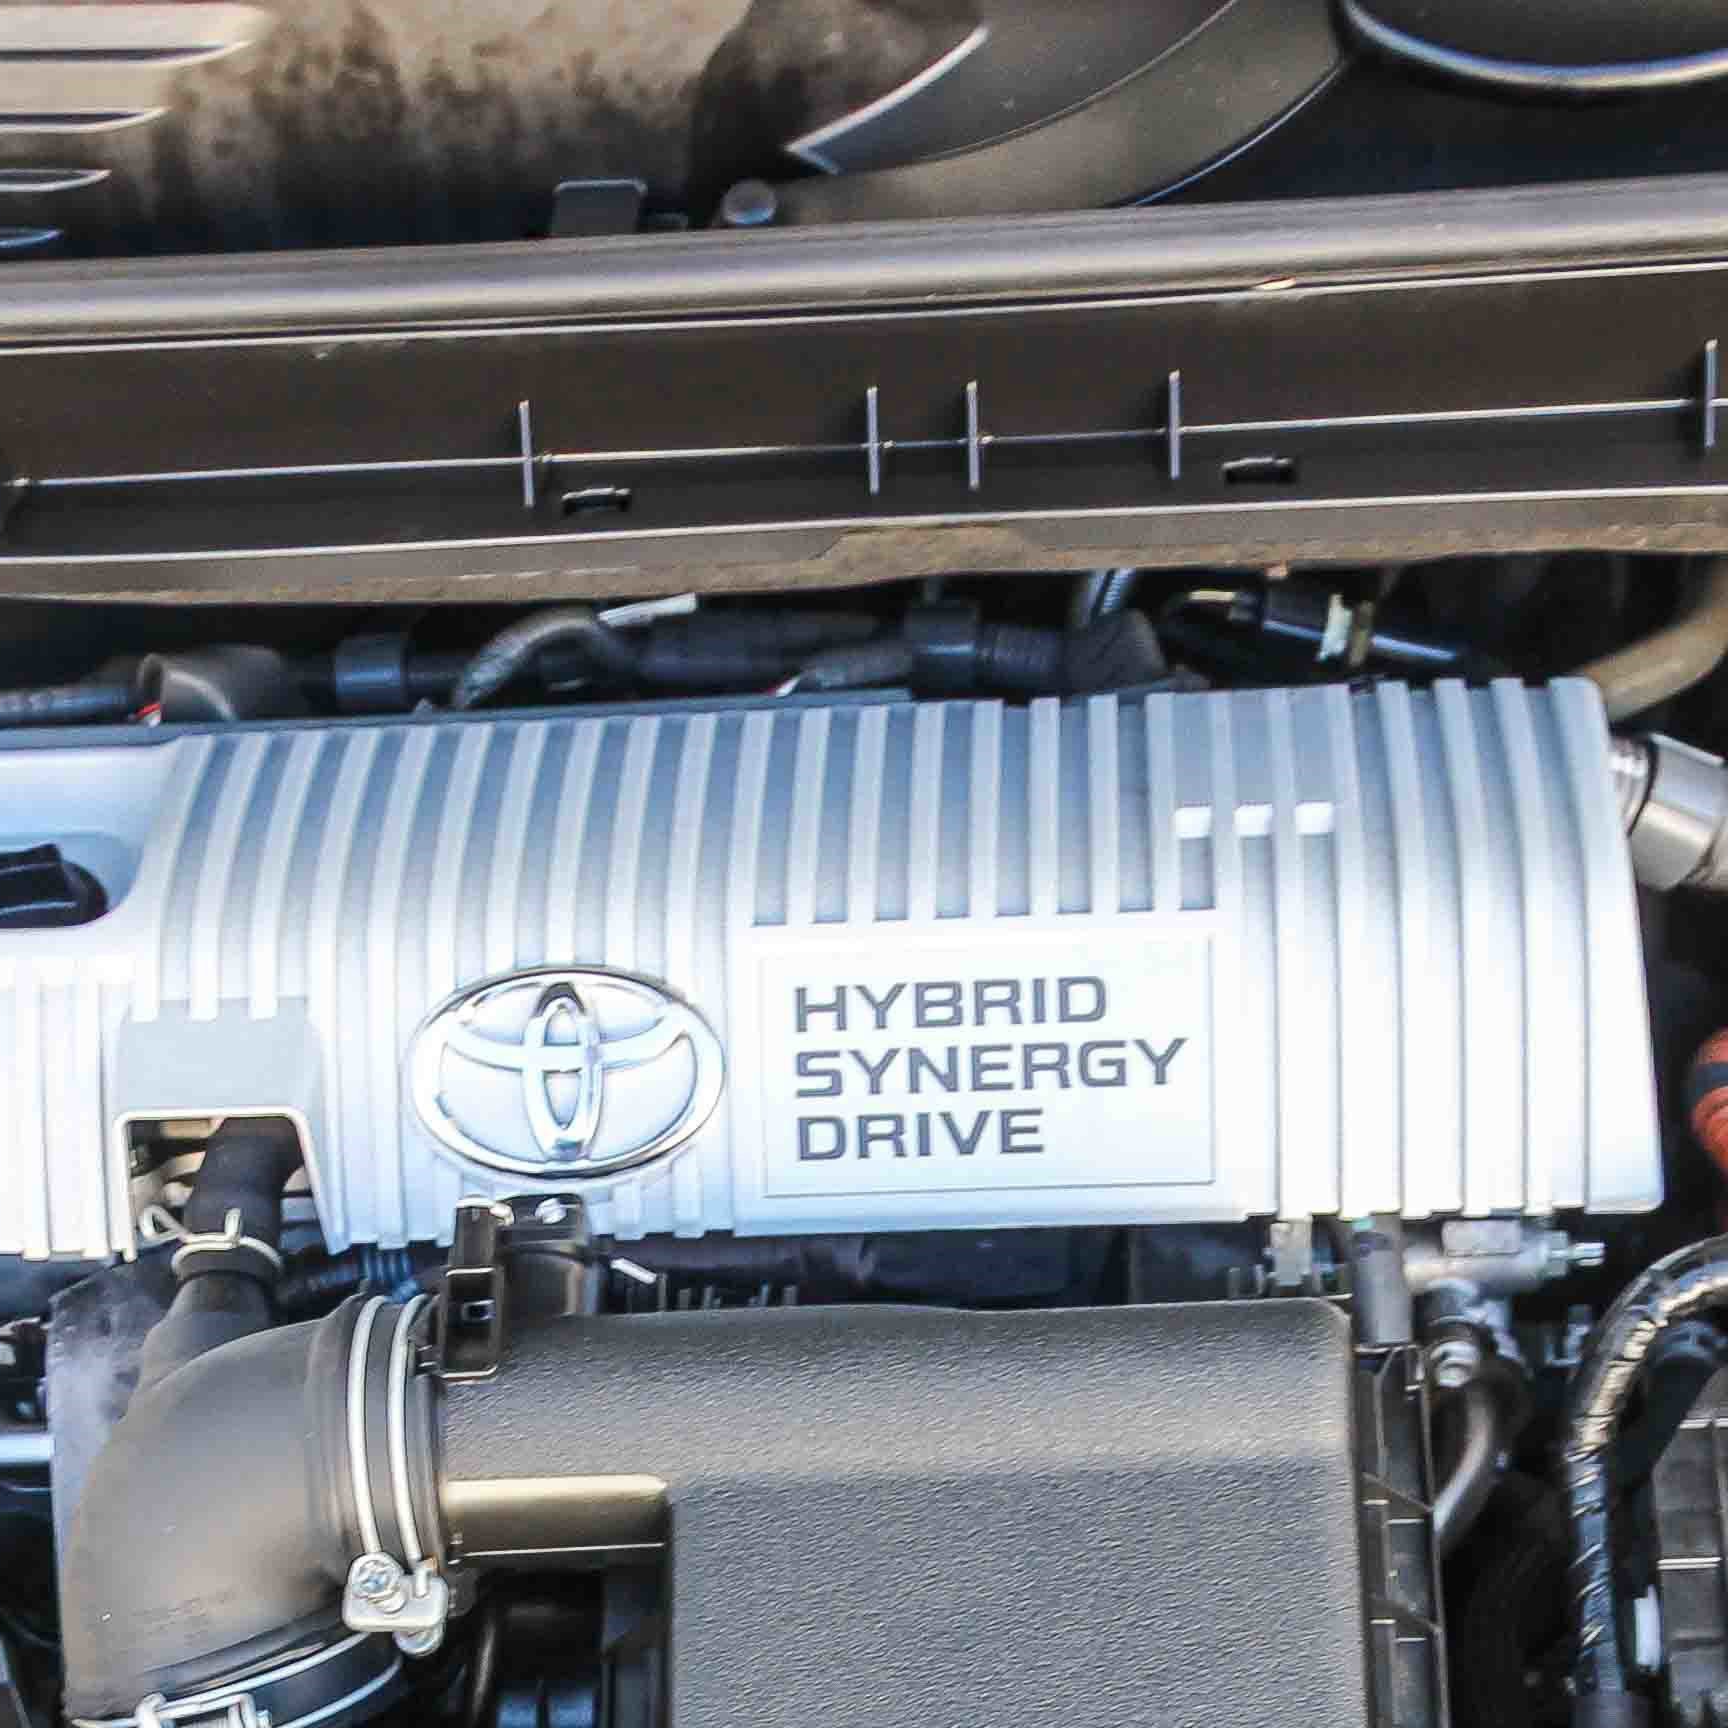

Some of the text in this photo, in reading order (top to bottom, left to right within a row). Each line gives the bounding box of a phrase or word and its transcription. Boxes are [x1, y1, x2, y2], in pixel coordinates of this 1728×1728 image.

[794, 976, 1108, 1033] HYBRID
[794, 1037, 1189, 1099] SYNERGY
[796, 1107, 1045, 1162] DRIVE
